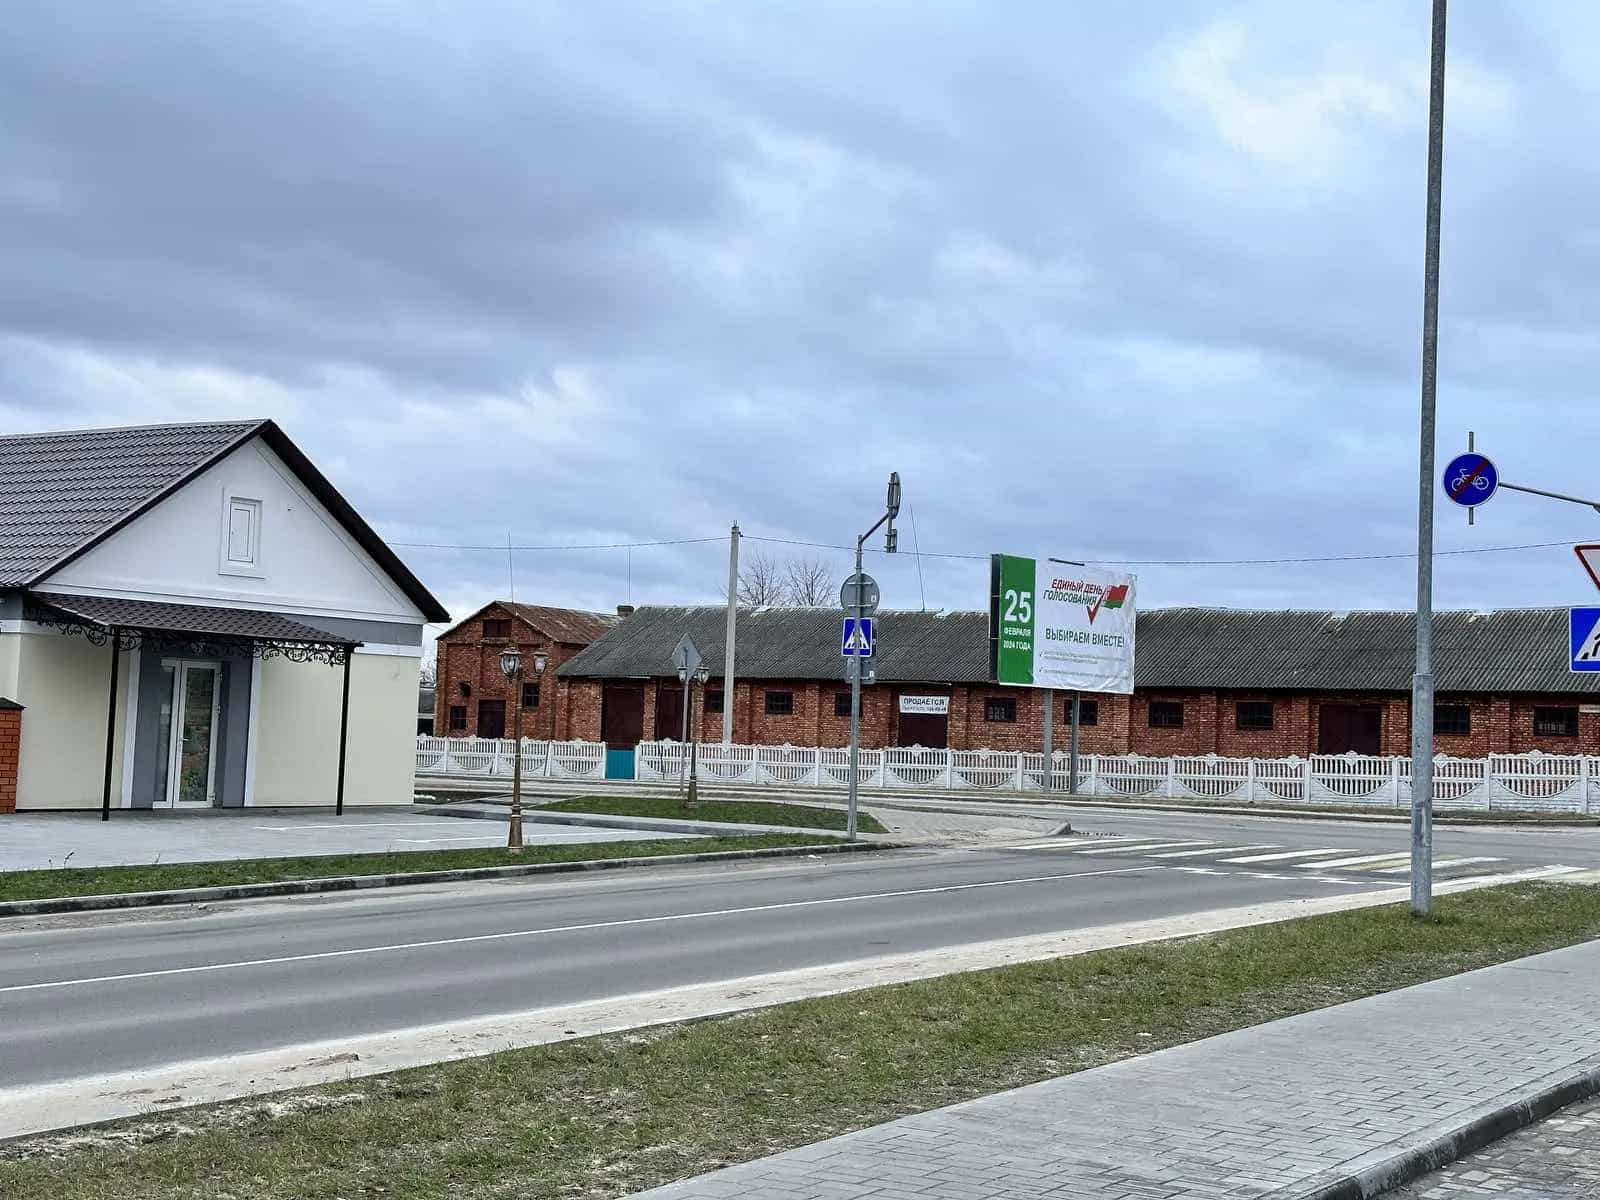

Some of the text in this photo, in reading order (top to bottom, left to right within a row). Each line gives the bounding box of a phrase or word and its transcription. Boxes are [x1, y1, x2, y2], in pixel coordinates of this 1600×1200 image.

[1051, 579, 1102, 595] ЕДИНЫЙ ДЕНЬ
[1043, 590, 1097, 606] ГОЛОСОВАНИЯ
[1004, 589, 1031, 624] 25
[1004, 627, 1031, 636] ФЕВРАЛЯ
[1046, 628, 1124, 648] ВЫБИРАЕМ ВМЕСТЕ!
[1004, 640, 1031, 650] 2024 ГОДА
